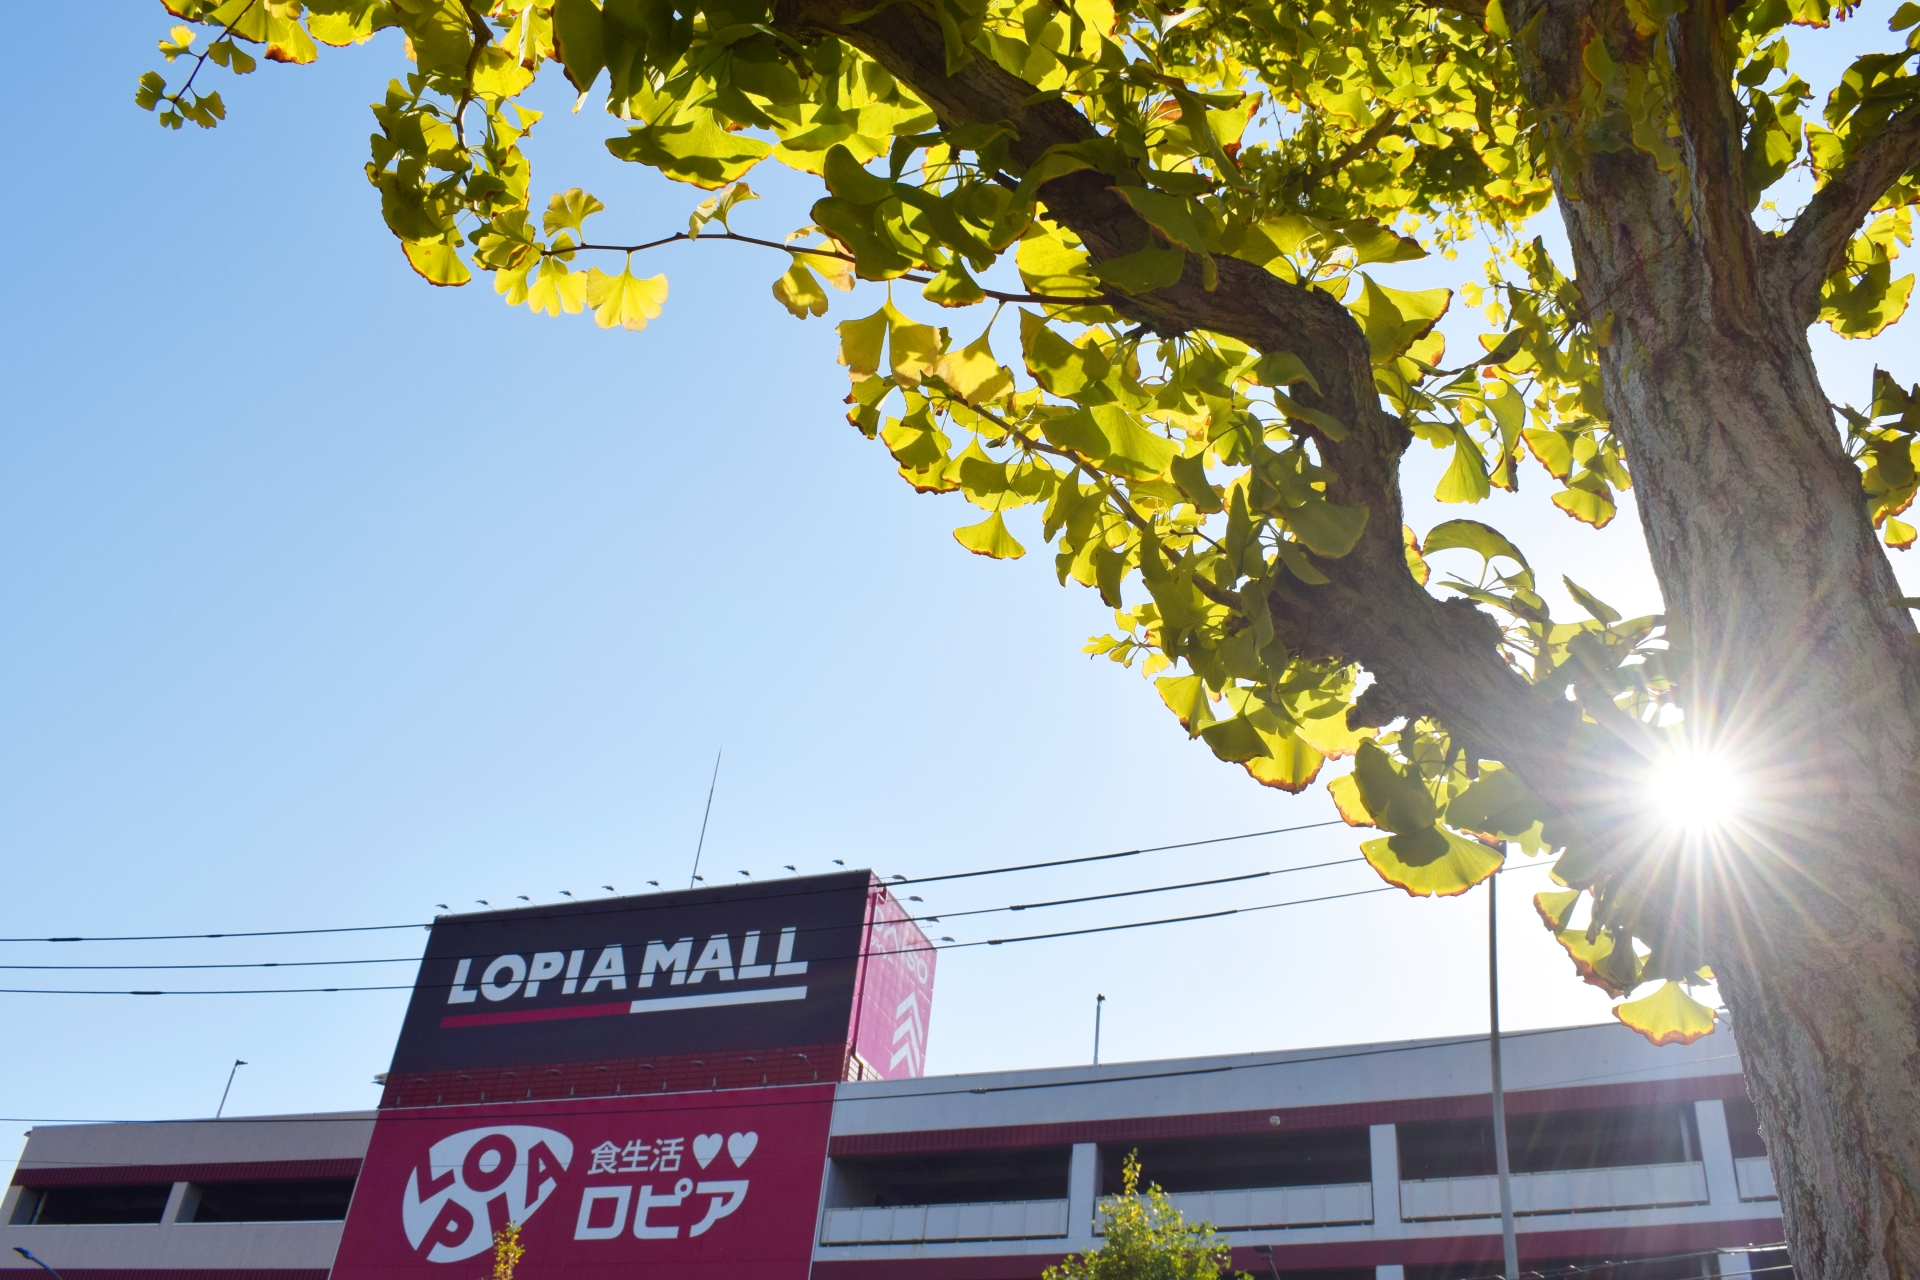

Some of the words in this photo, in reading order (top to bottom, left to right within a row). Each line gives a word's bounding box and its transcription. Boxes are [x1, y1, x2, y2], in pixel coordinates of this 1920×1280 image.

[447, 943, 627, 1005] LOPIA
[638, 927, 808, 988] MALL
[587, 1138, 684, 1175] 食生活
[574, 1178, 749, 1240] ロピア
